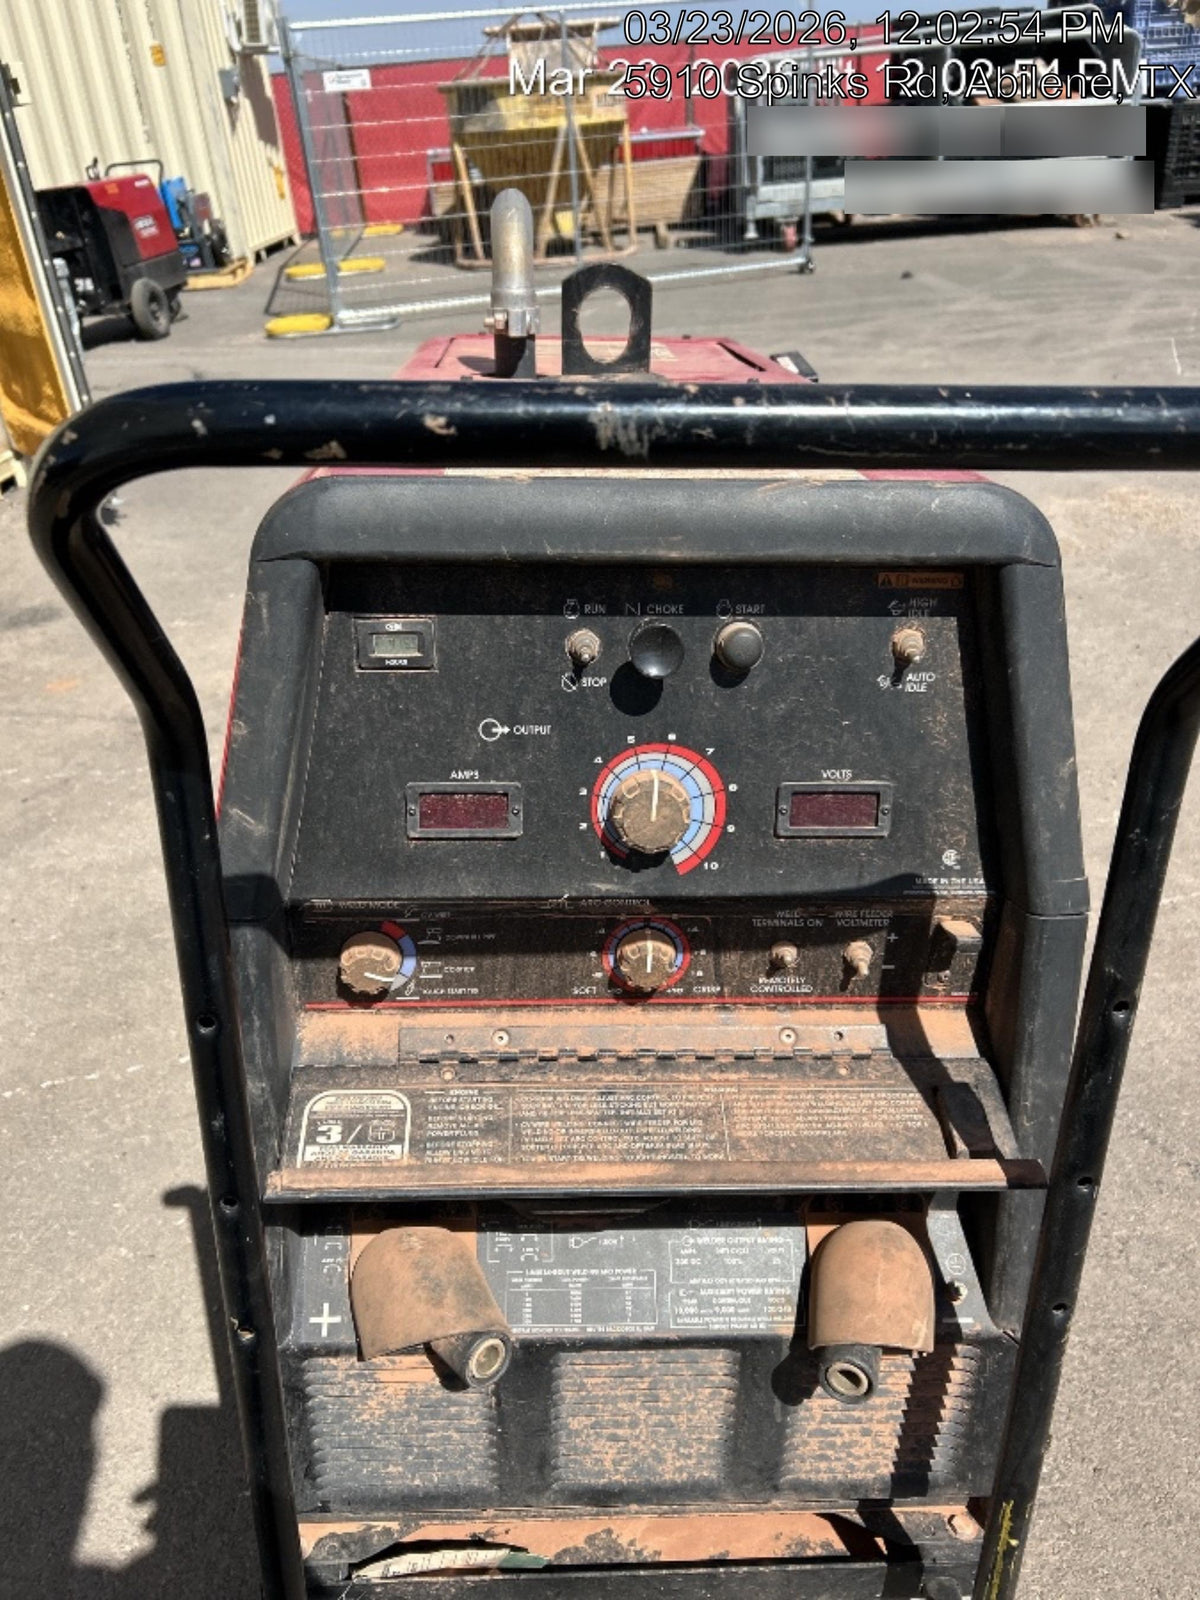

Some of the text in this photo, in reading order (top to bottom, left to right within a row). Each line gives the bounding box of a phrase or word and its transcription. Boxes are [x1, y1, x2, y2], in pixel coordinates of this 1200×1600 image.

[583, 603, 606, 614] RUN
[646, 603, 684, 614] CHOKE
[735, 603, 766, 614] START
[581, 677, 607, 688] STOP
[906, 672, 936, 682] AUTO
[905, 683, 928, 692] IDLE
[513, 724, 552, 735] OUTPUT
[450, 769, 479, 780] AMPS
[821, 769, 852, 780] VOLTS
[704, 862, 719, 870] 10
[752, 919, 825, 927] TERMINALS ON
[836, 919, 890, 927] VOLTMETER
[572, 986, 597, 995] SOFT
[750, 984, 813, 993] CONTROLLED
[315, 1124, 343, 1144] 3
